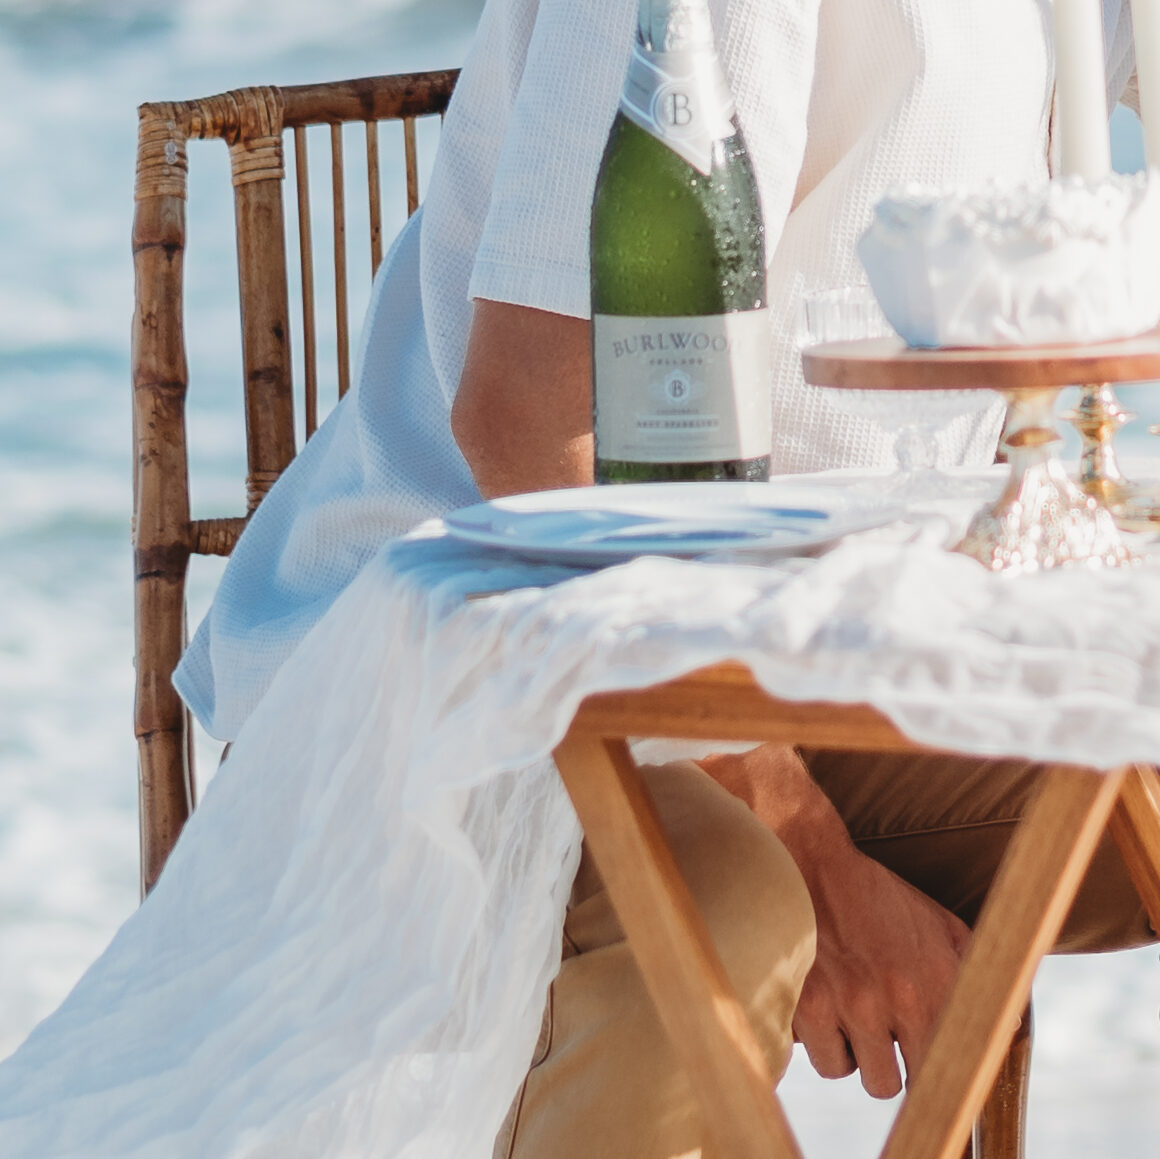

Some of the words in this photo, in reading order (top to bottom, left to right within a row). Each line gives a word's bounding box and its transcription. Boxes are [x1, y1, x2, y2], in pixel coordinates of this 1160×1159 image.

[671, 92, 692, 126] B
[612, 331, 740, 359] BURLWOO
[671, 379, 684, 398] B
